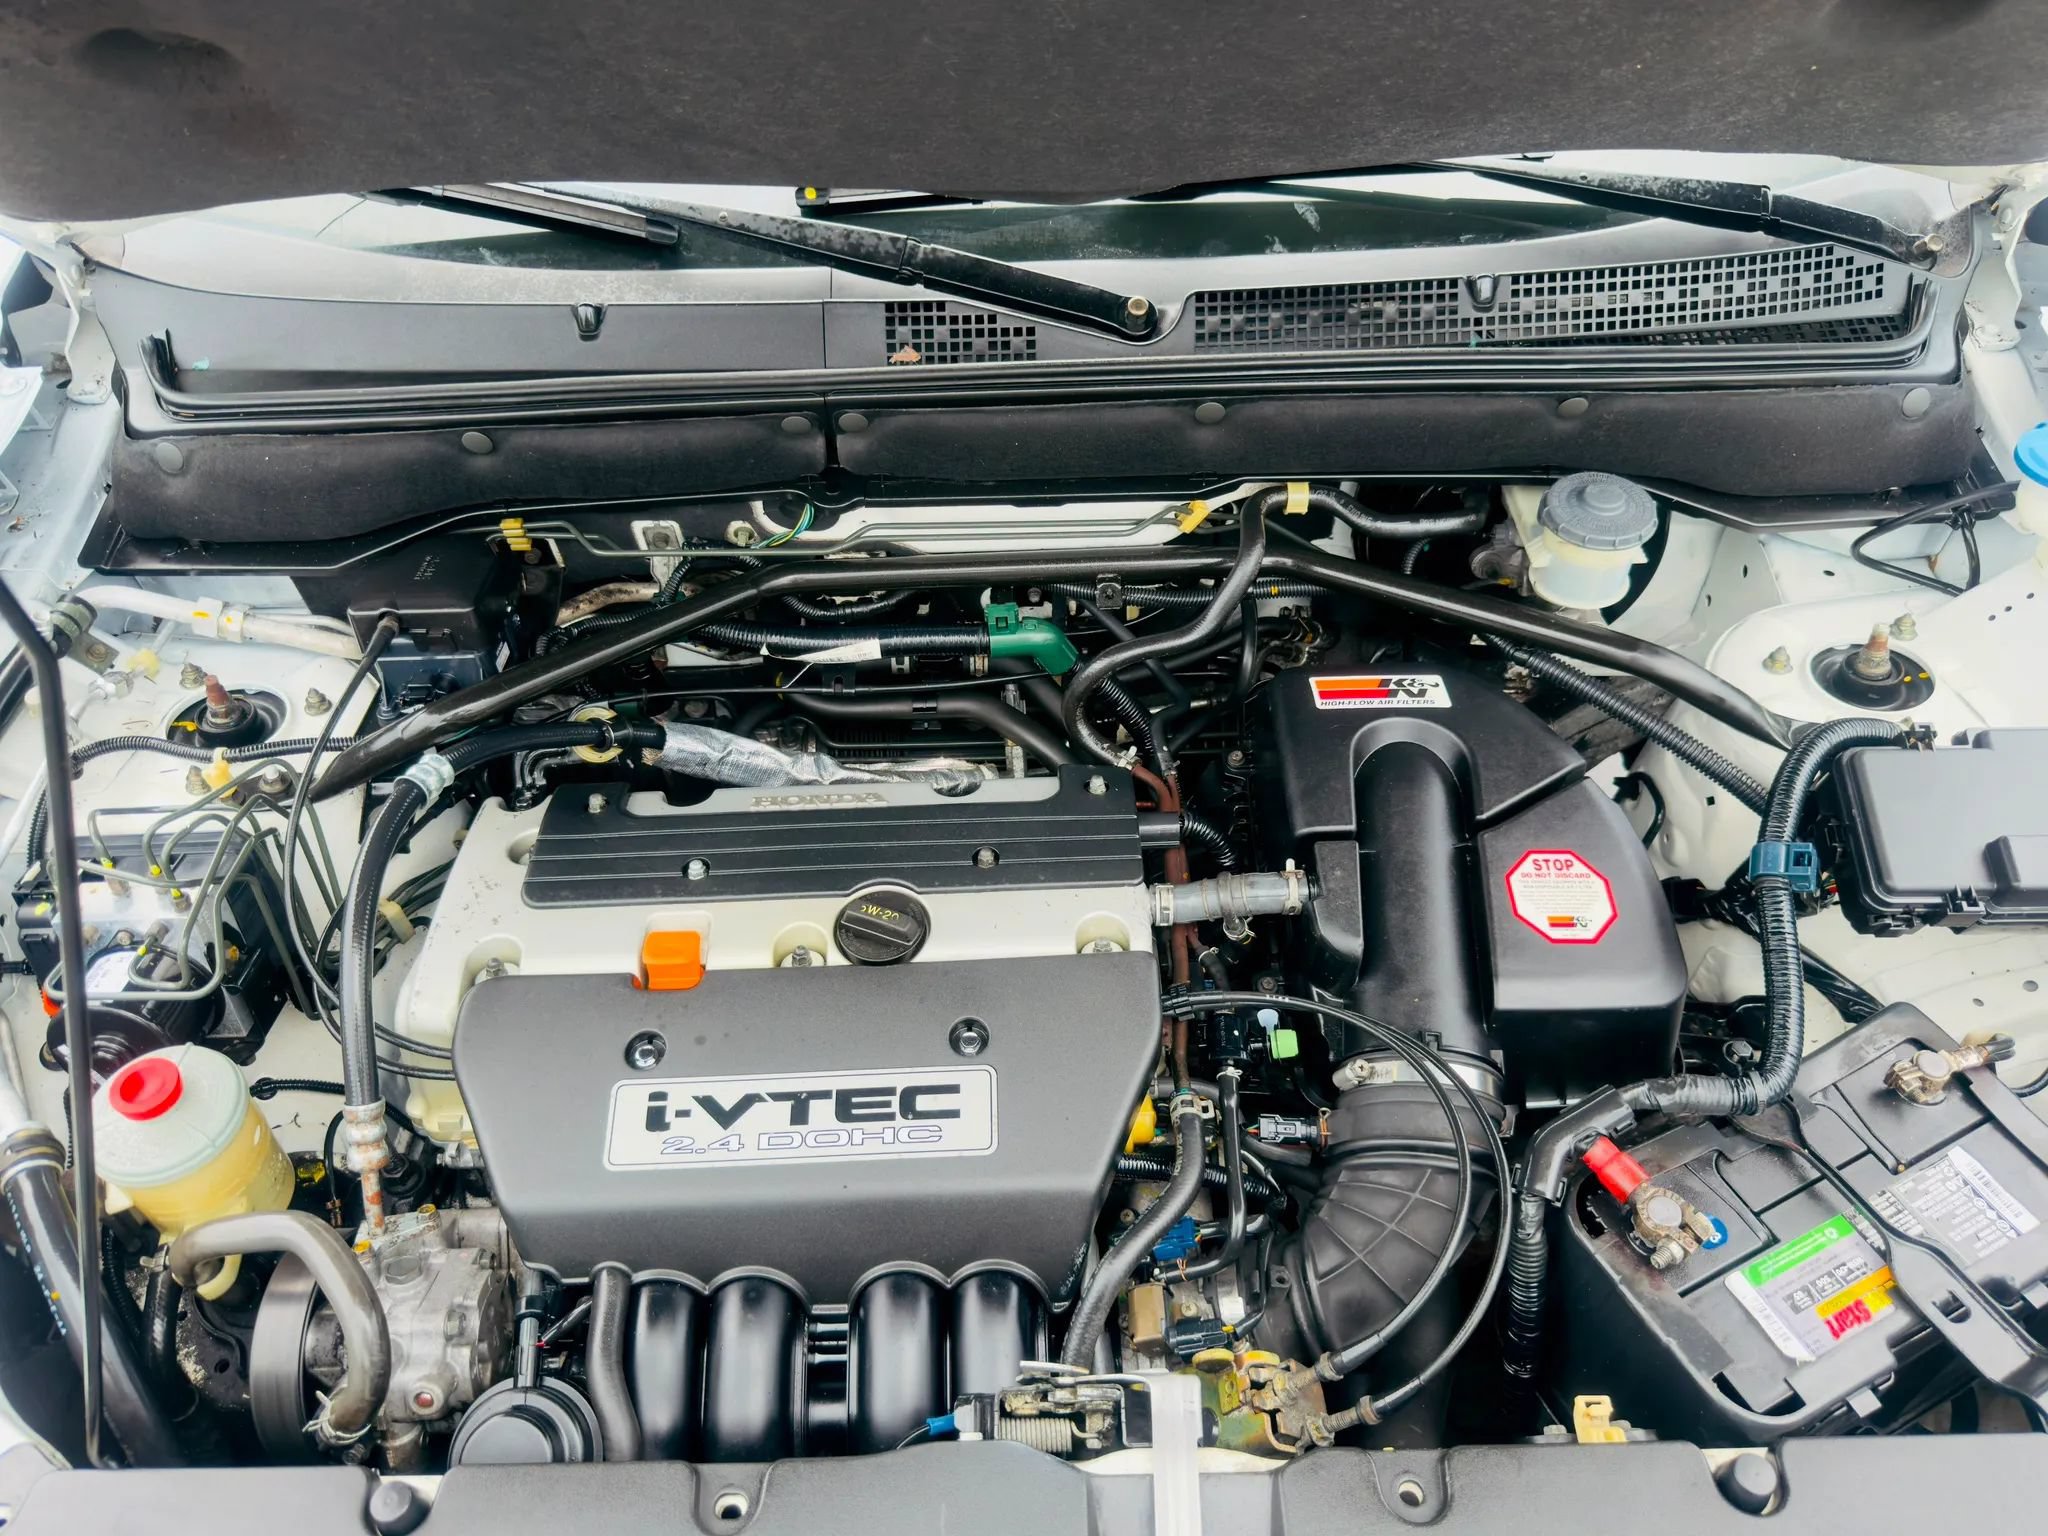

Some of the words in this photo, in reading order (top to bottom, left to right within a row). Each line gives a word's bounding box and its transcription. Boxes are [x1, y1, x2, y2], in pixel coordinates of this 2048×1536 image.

[1378, 678, 1440, 699] K&N
[751, 793, 888, 811] HONDA
[1532, 859, 1574, 871] STOP
[645, 1084, 961, 1132] i-VTEC
[660, 1133, 745, 1155] 2.4
[757, 1125, 943, 1151] DOHC
